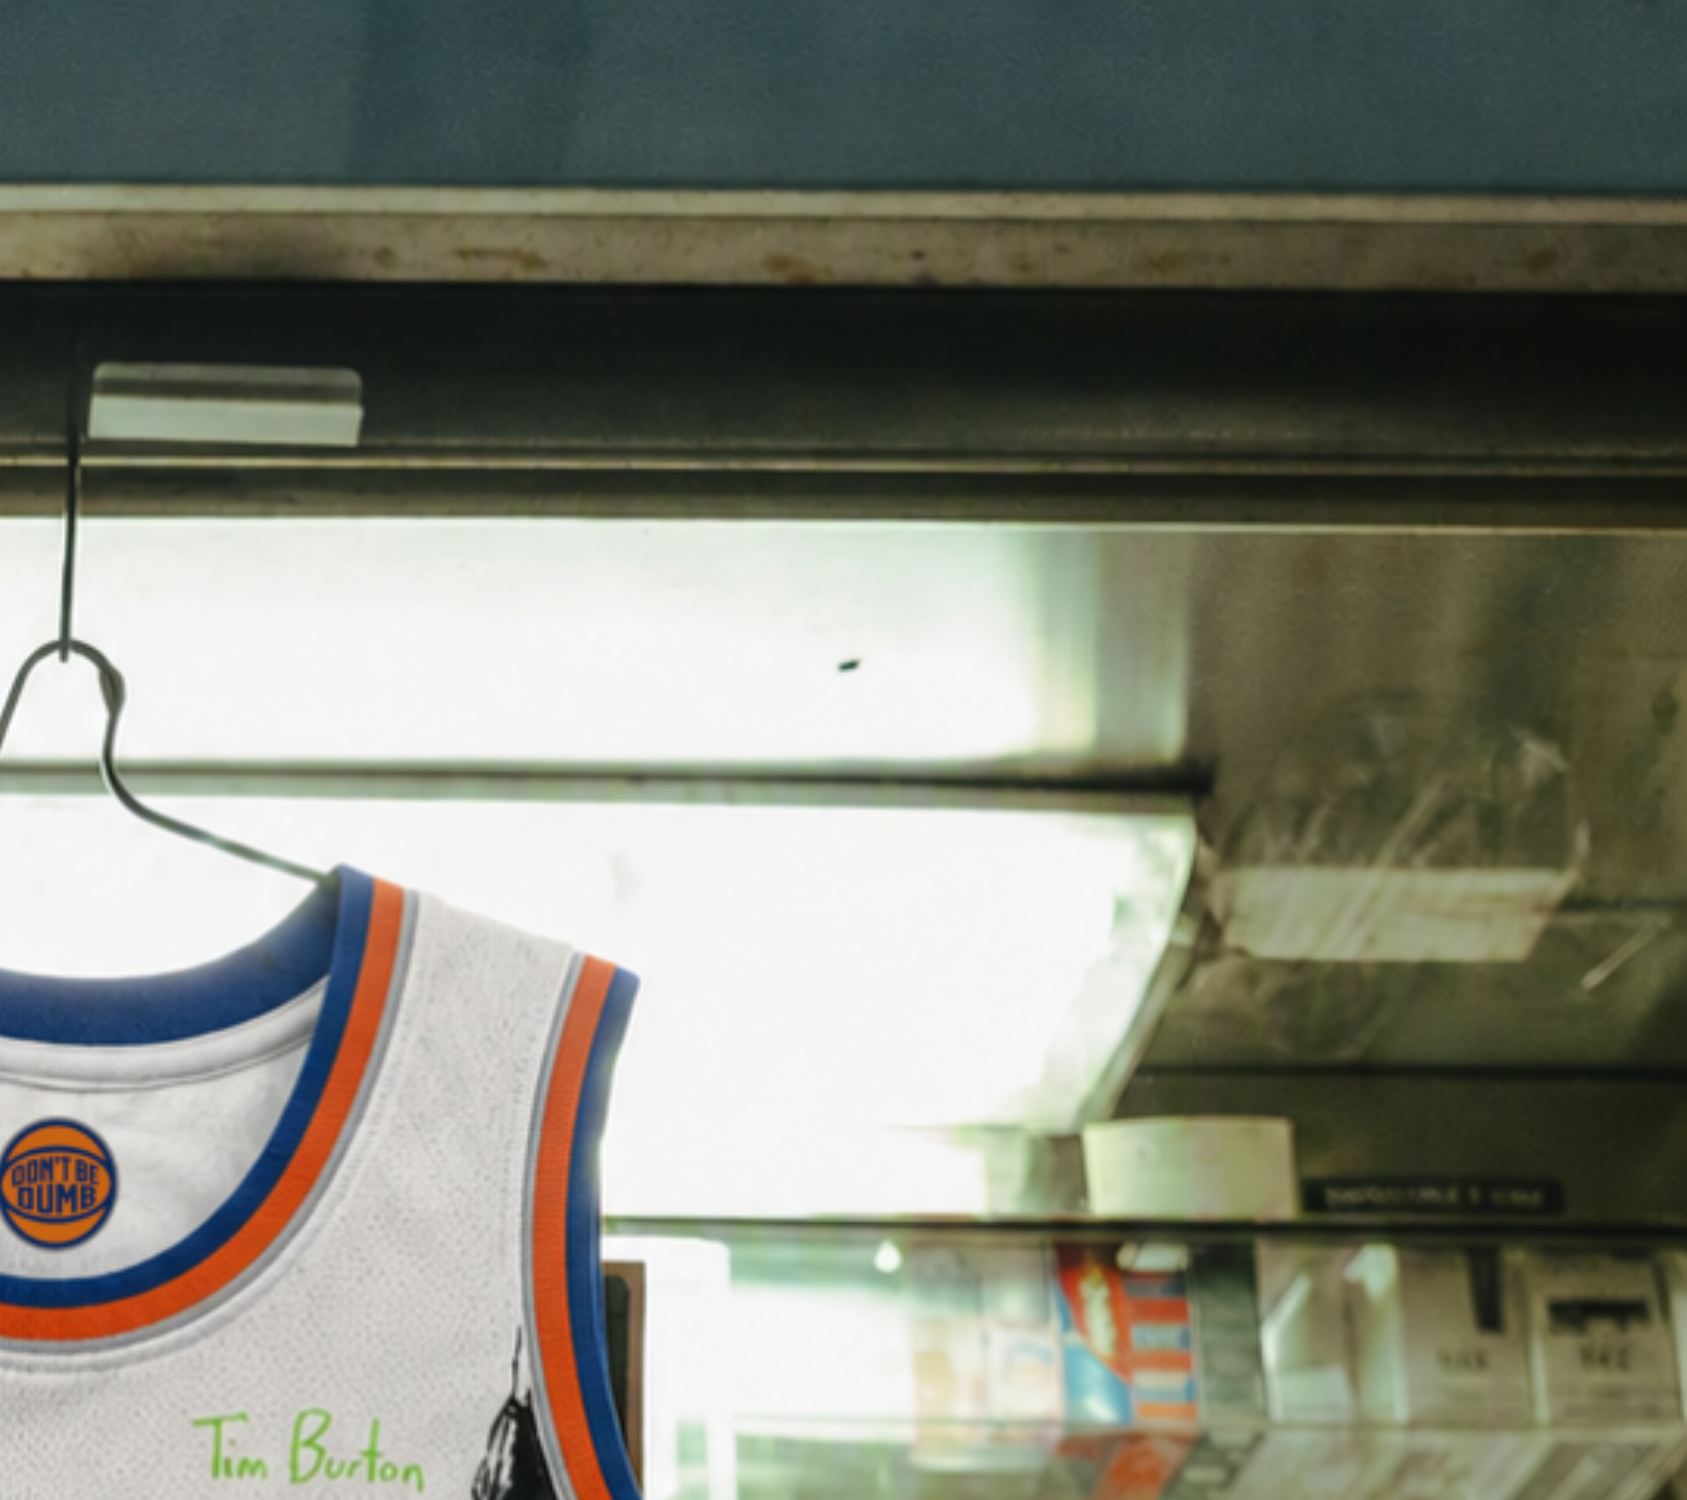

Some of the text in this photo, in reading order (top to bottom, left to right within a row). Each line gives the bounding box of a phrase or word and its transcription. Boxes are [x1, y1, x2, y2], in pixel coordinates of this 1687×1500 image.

[12, 1156, 100, 1187] DON'T BE
[18, 1184, 97, 1214] DUMB
[192, 1408, 425, 1493] Tim Burton
